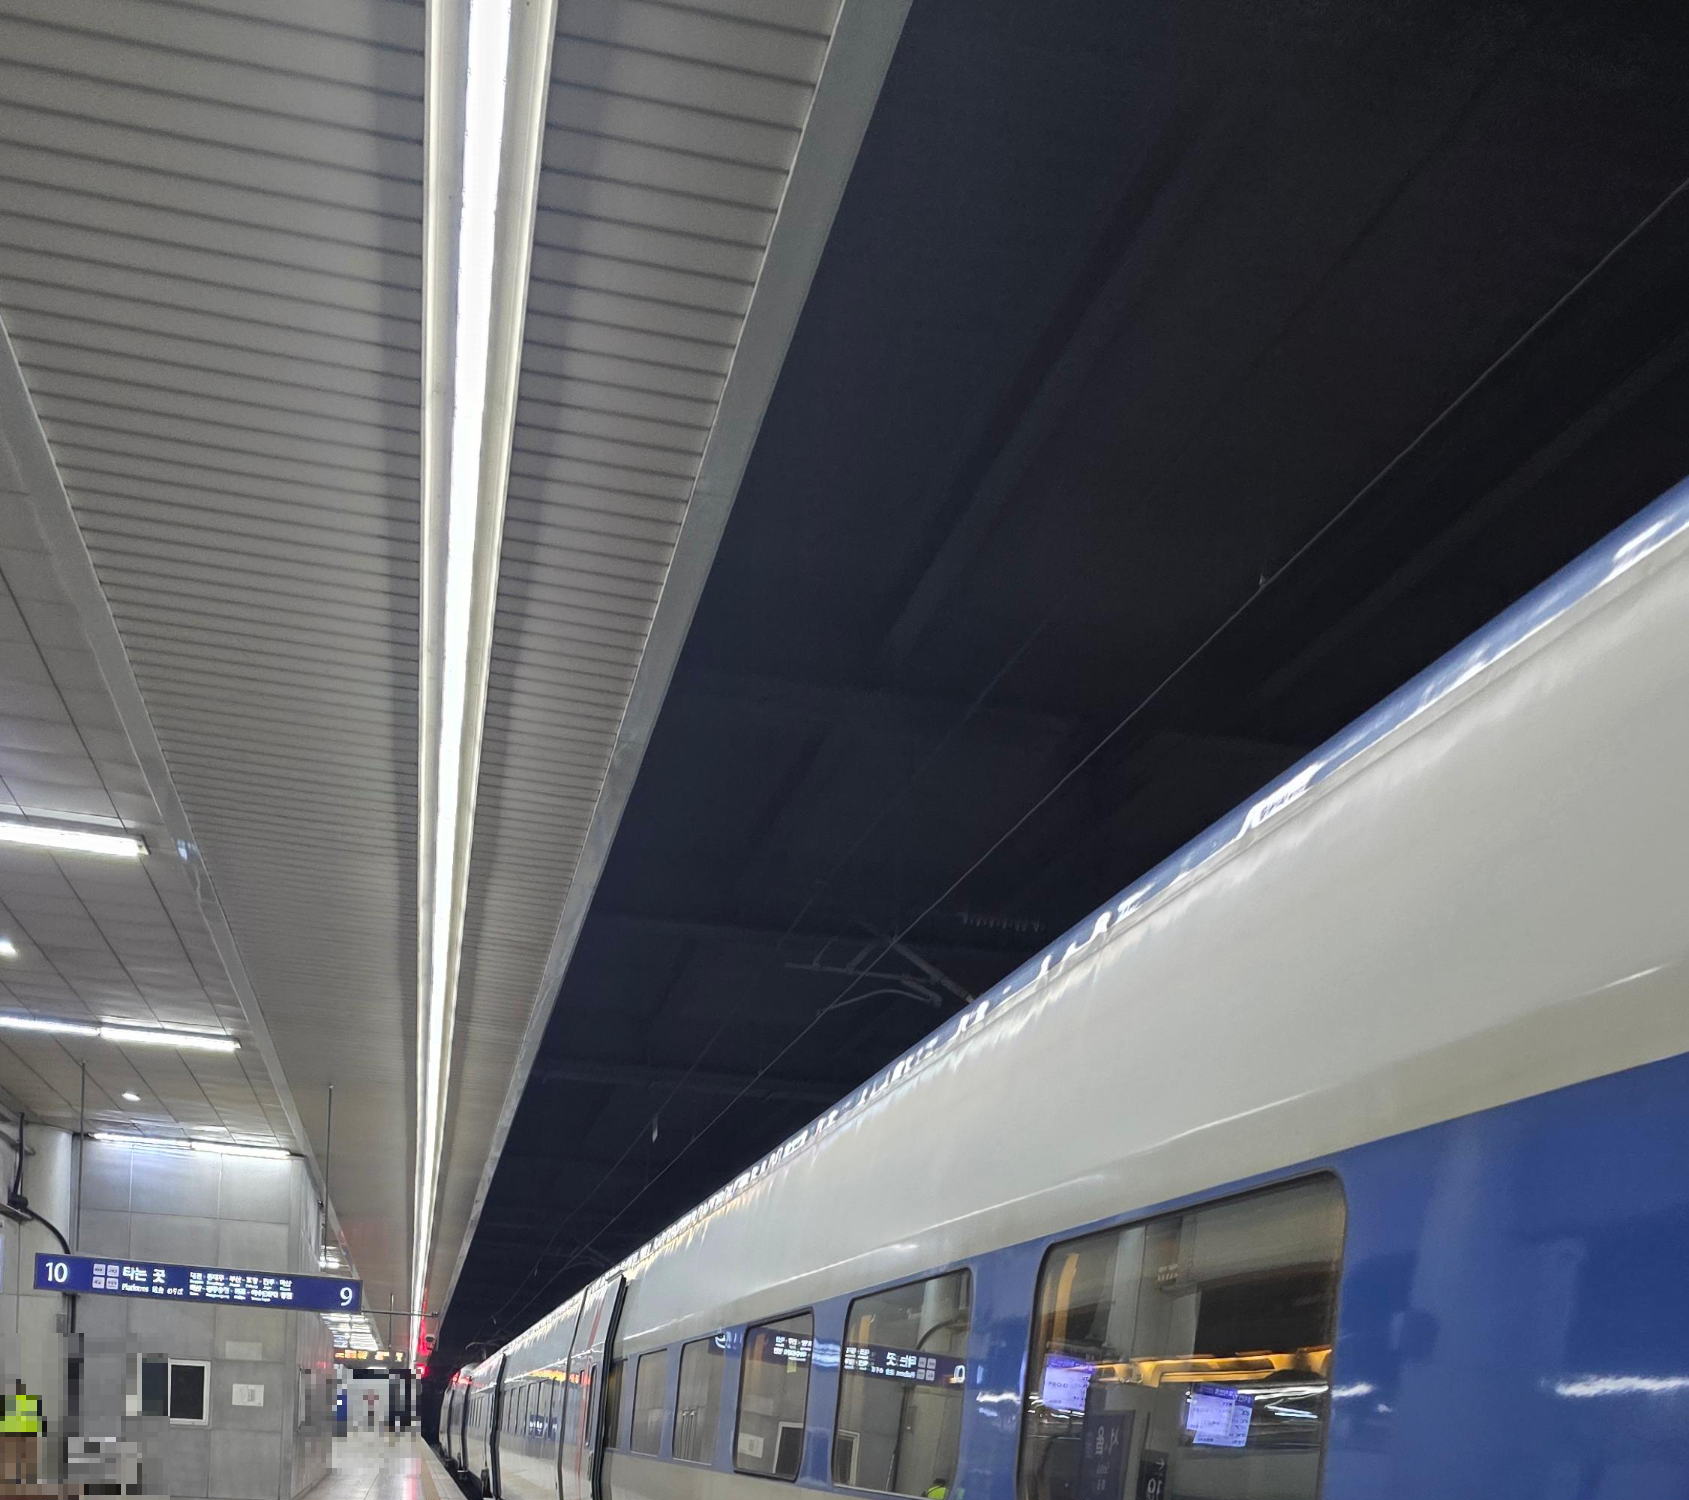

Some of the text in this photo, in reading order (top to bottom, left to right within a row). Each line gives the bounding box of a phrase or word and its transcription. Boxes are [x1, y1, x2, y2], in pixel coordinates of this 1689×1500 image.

[45, 1262, 68, 1283] 10
[122, 1266, 147, 1282] 타는
[152, 1268, 166, 1284] 곳
[340, 1286, 353, 1307] 9
